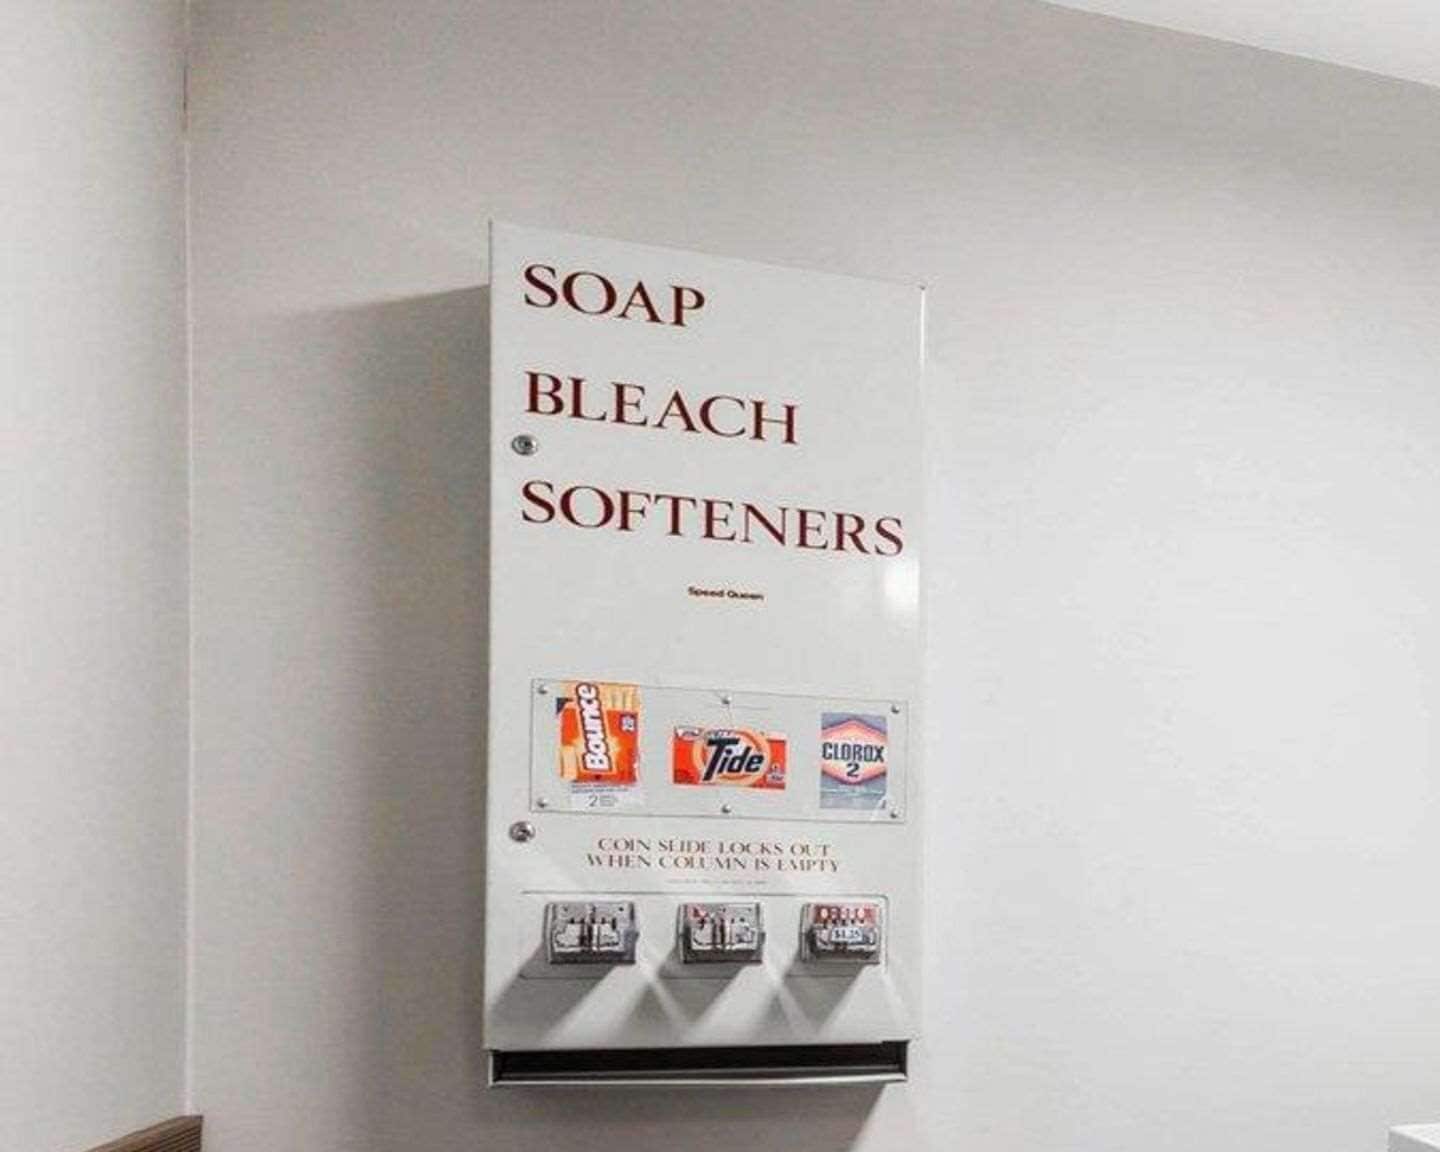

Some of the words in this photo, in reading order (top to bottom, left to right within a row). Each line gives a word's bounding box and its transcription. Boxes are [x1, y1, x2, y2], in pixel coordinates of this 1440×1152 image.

[523, 264, 706, 327] SOAP
[525, 371, 798, 444] BLEACH
[521, 480, 905, 557] SOFTENERS
[688, 586, 724, 598] Speed
[727, 589, 764, 600] Queen
[702, 738, 764, 781] Tide
[822, 742, 884, 762] CLOROX
[846, 762, 860, 777] 2
[598, 838, 650, 851] COIN
[658, 839, 708, 853] SLIDE
[718, 841, 783, 855] LOCKS
[790, 843, 831, 856] OUT
[586, 853, 651, 867] WHEN
[658, 855, 746, 870] COLUMN
[755, 858, 769, 870] IS
[777, 859, 839, 872] EMPTY
